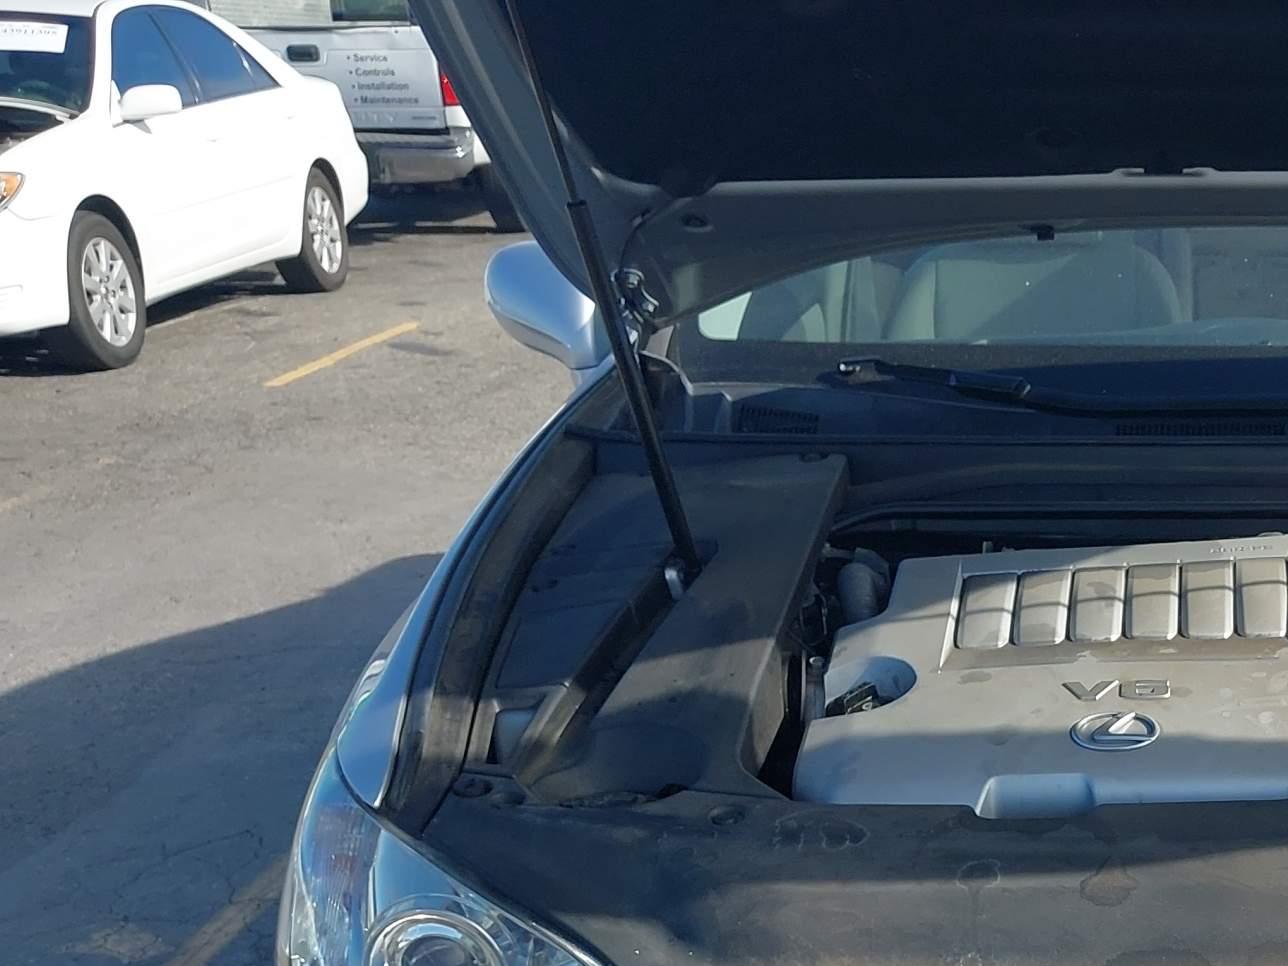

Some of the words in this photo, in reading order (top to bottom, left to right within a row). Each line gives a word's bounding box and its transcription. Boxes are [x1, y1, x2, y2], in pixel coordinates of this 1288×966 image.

[353, 53, 388, 62] Service
[355, 67, 395, 76] Controls
[357, 82, 409, 90] Installation
[360, 95, 419, 104] Maintenance
[1061, 679, 1171, 701] V6
